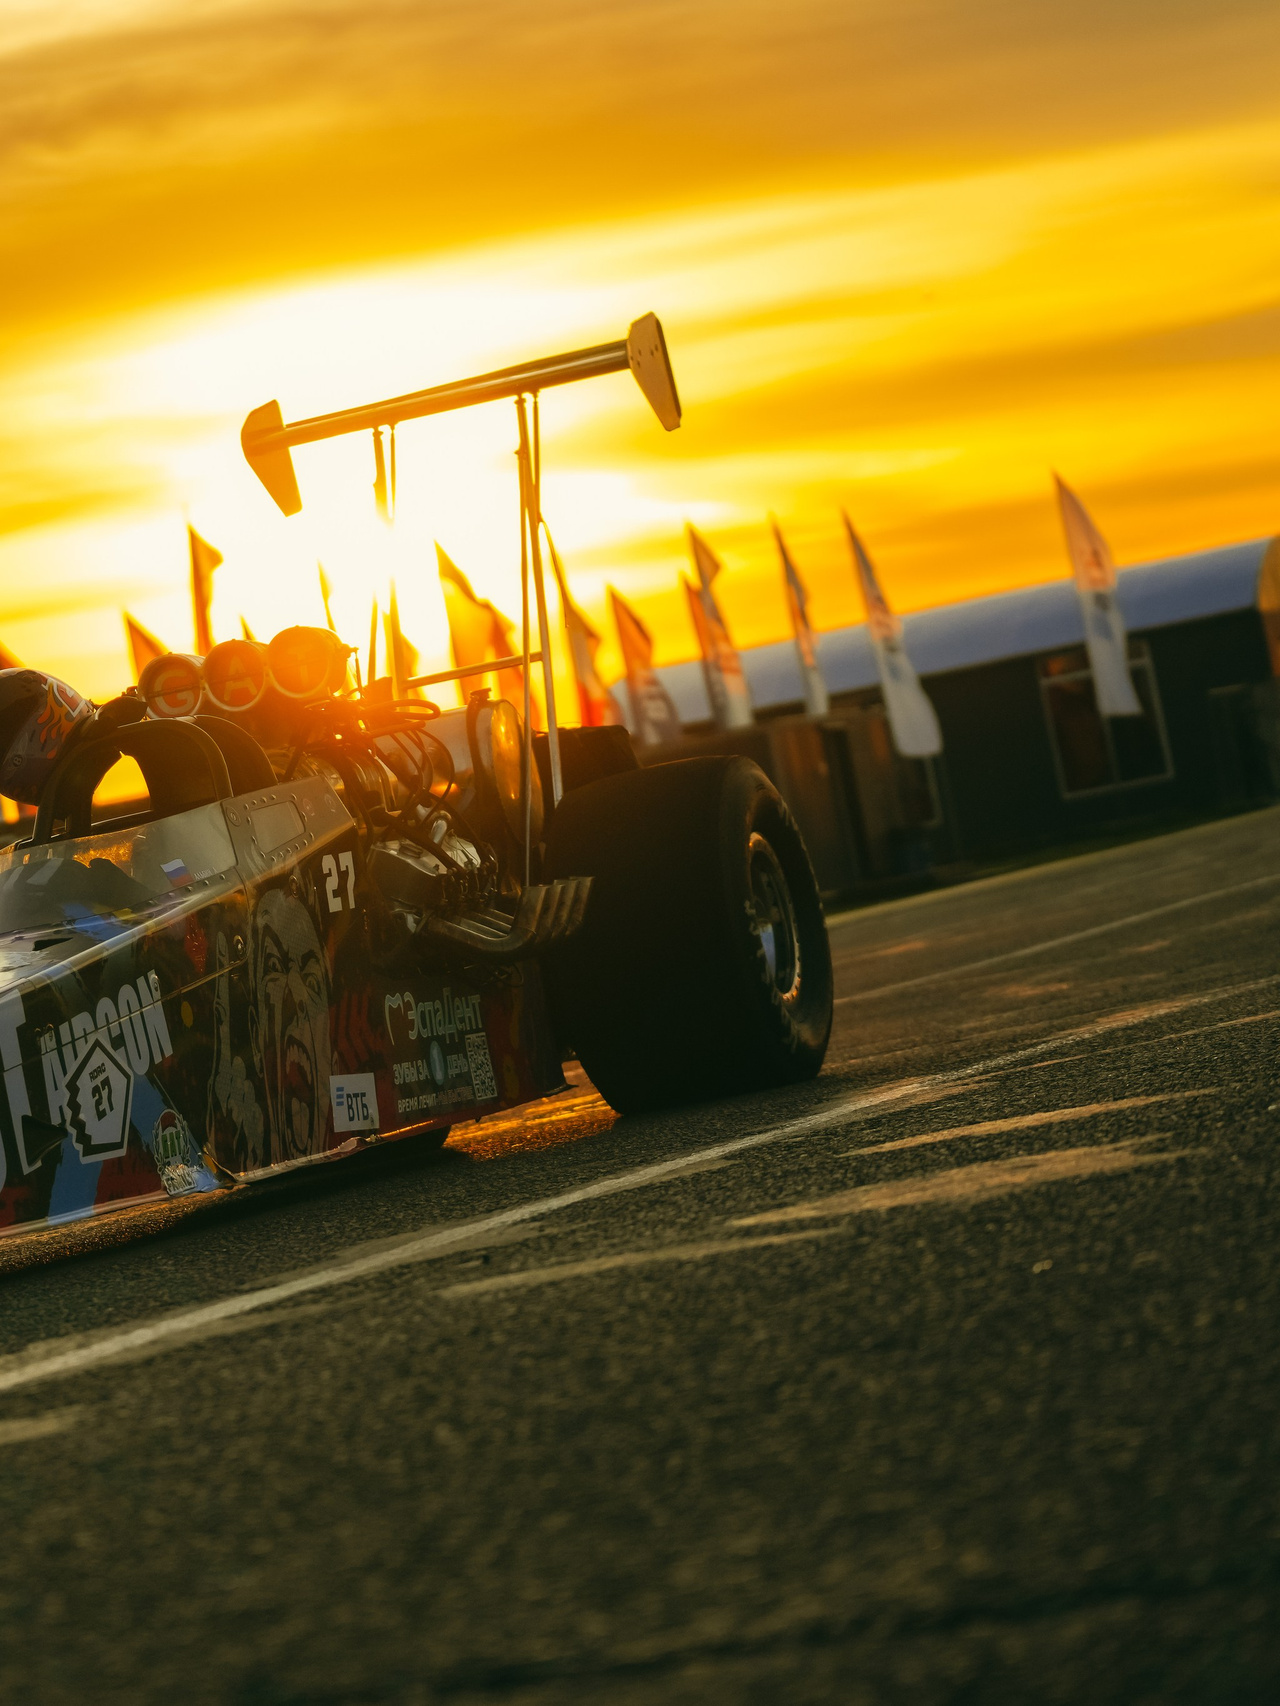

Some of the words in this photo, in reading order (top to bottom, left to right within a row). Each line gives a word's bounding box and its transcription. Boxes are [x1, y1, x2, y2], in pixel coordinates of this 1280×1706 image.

[321, 851, 356, 913] 27
[392, 1061, 418, 1085] ЗУБЫ
[417, 1059, 431, 1081] ЗА
[446, 1053, 469, 1079] ДЕНЬ
[91, 1075, 115, 1122] 27
[346, 1092, 369, 1122] ВТБ
